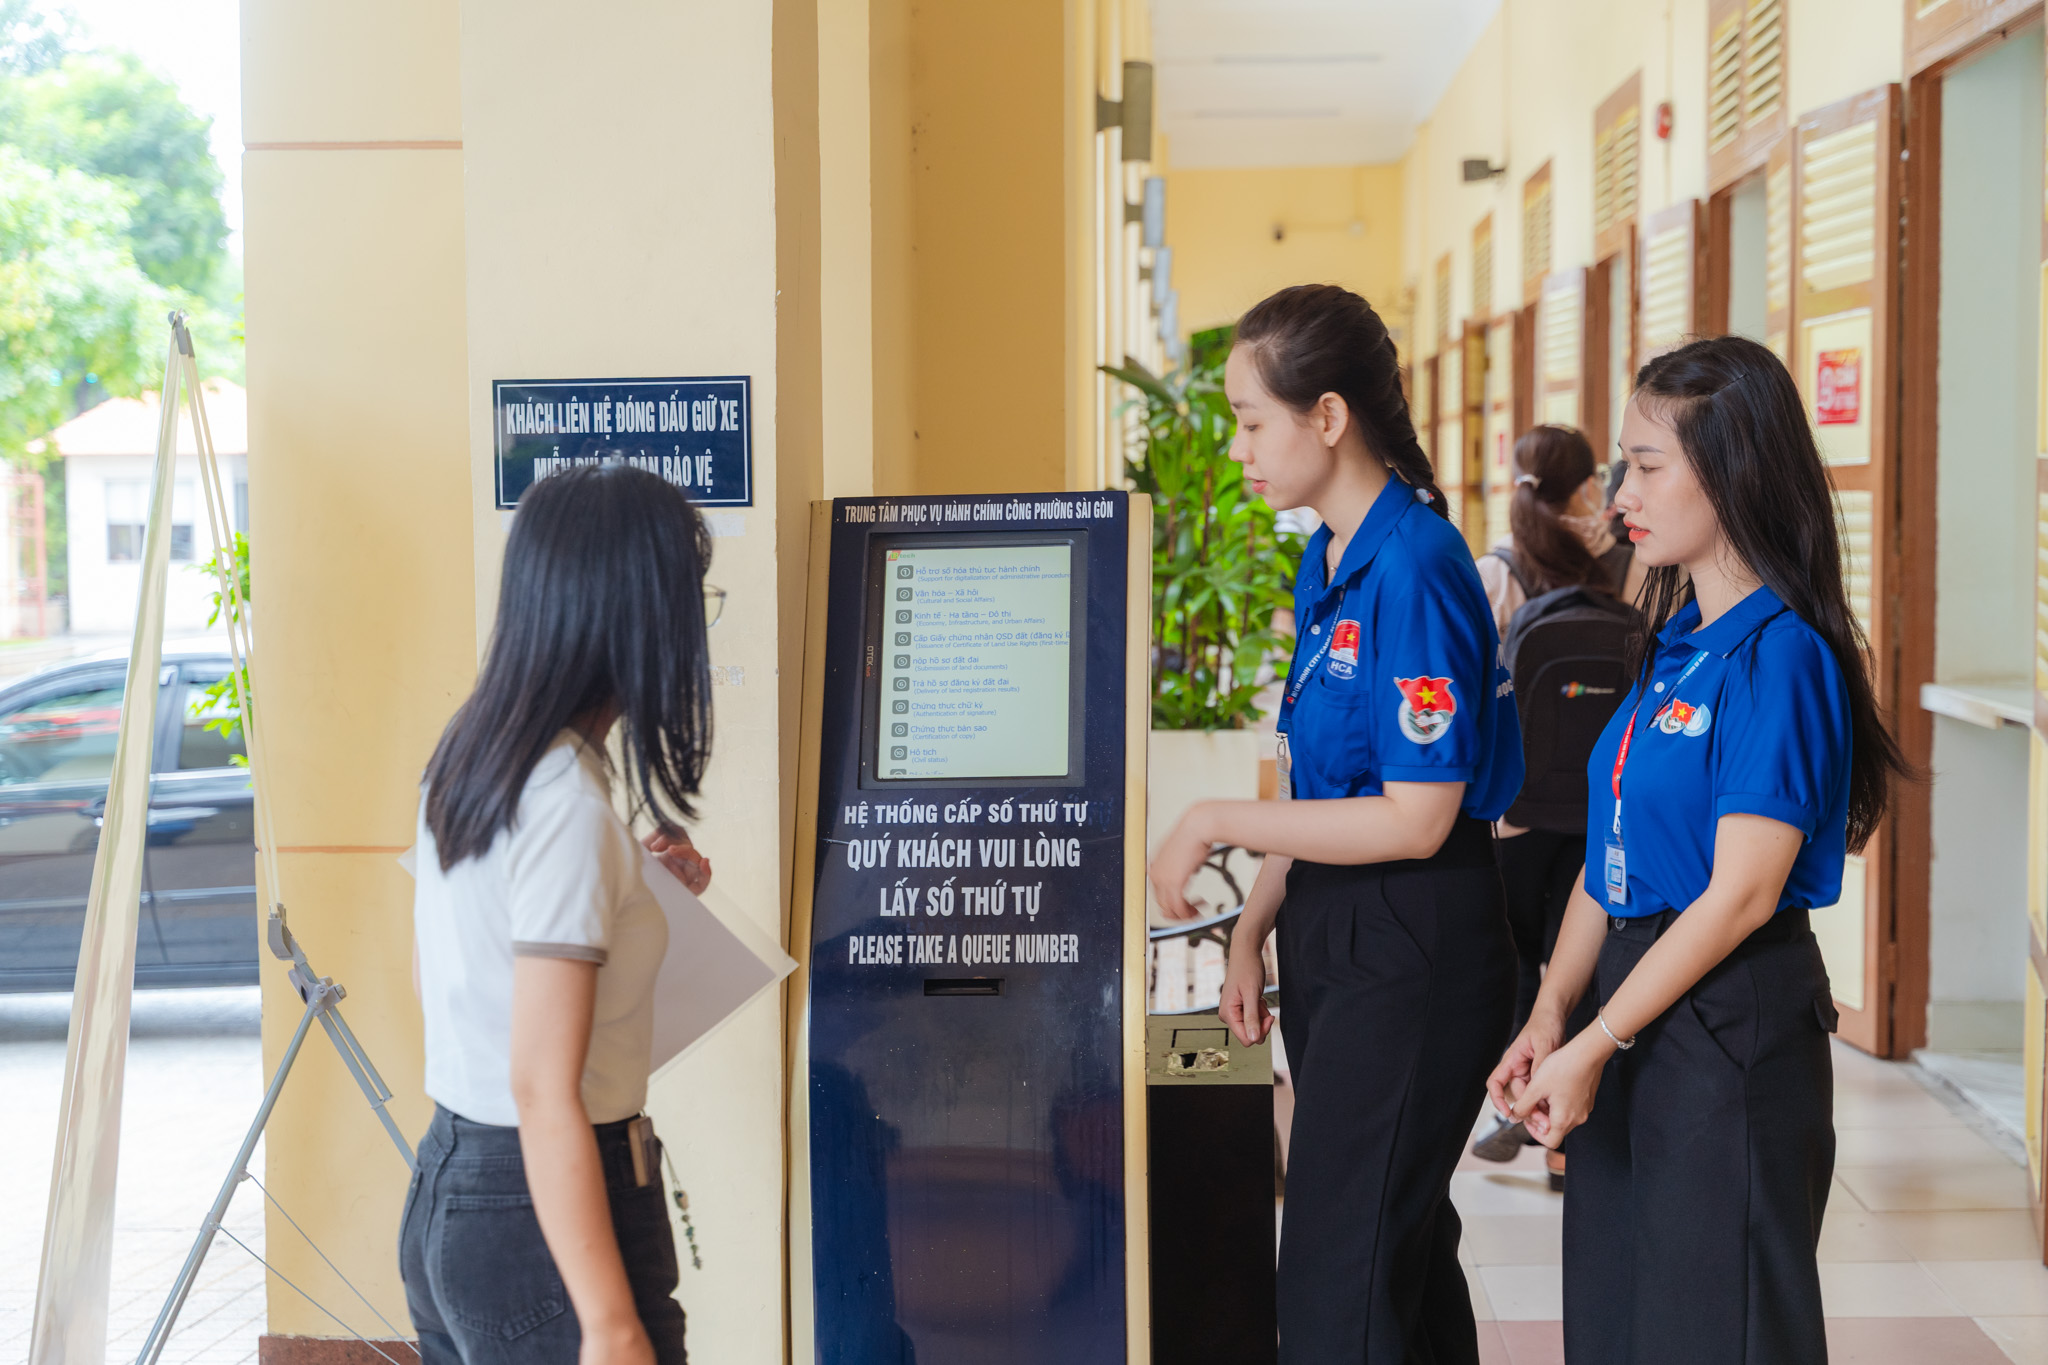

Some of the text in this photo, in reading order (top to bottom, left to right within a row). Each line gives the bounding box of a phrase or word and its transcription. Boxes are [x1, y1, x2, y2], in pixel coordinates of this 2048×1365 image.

[506, 390, 738, 440] KHÁCH LIÊN HỆ ĐÓNG DẤU GIỮ XE
[663, 445, 692, 487] BẢO
[695, 448, 713, 493] VỆ
[845, 506, 875, 523] TRUNG
[879, 501, 898, 522] TÂM
[901, 505, 927, 526] PHỤC
[930, 505, 942, 525] VỤ
[945, 500, 971, 521] HÀNH
[974, 499, 1003, 520] CHÍNH
[1034, 498, 1073, 519] PHƯỜNG
[1076, 497, 1091, 518] SÀI
[1094, 497, 1113, 518] GÒN
[1308, 653, 1321, 668] CITY
[1331, 661, 1353, 675] HCA
[845, 797, 1088, 828] HỆ THỐNG CẤP SỐ THỨ TỰ
[848, 832, 1080, 871] QUÝ KHÁCH VUI LÒNG
[880, 877, 1042, 922] LẤY SỐ THỨ TỰ
[849, 935, 1079, 967] PLEASE TAKE A QUEUE NUMBER
